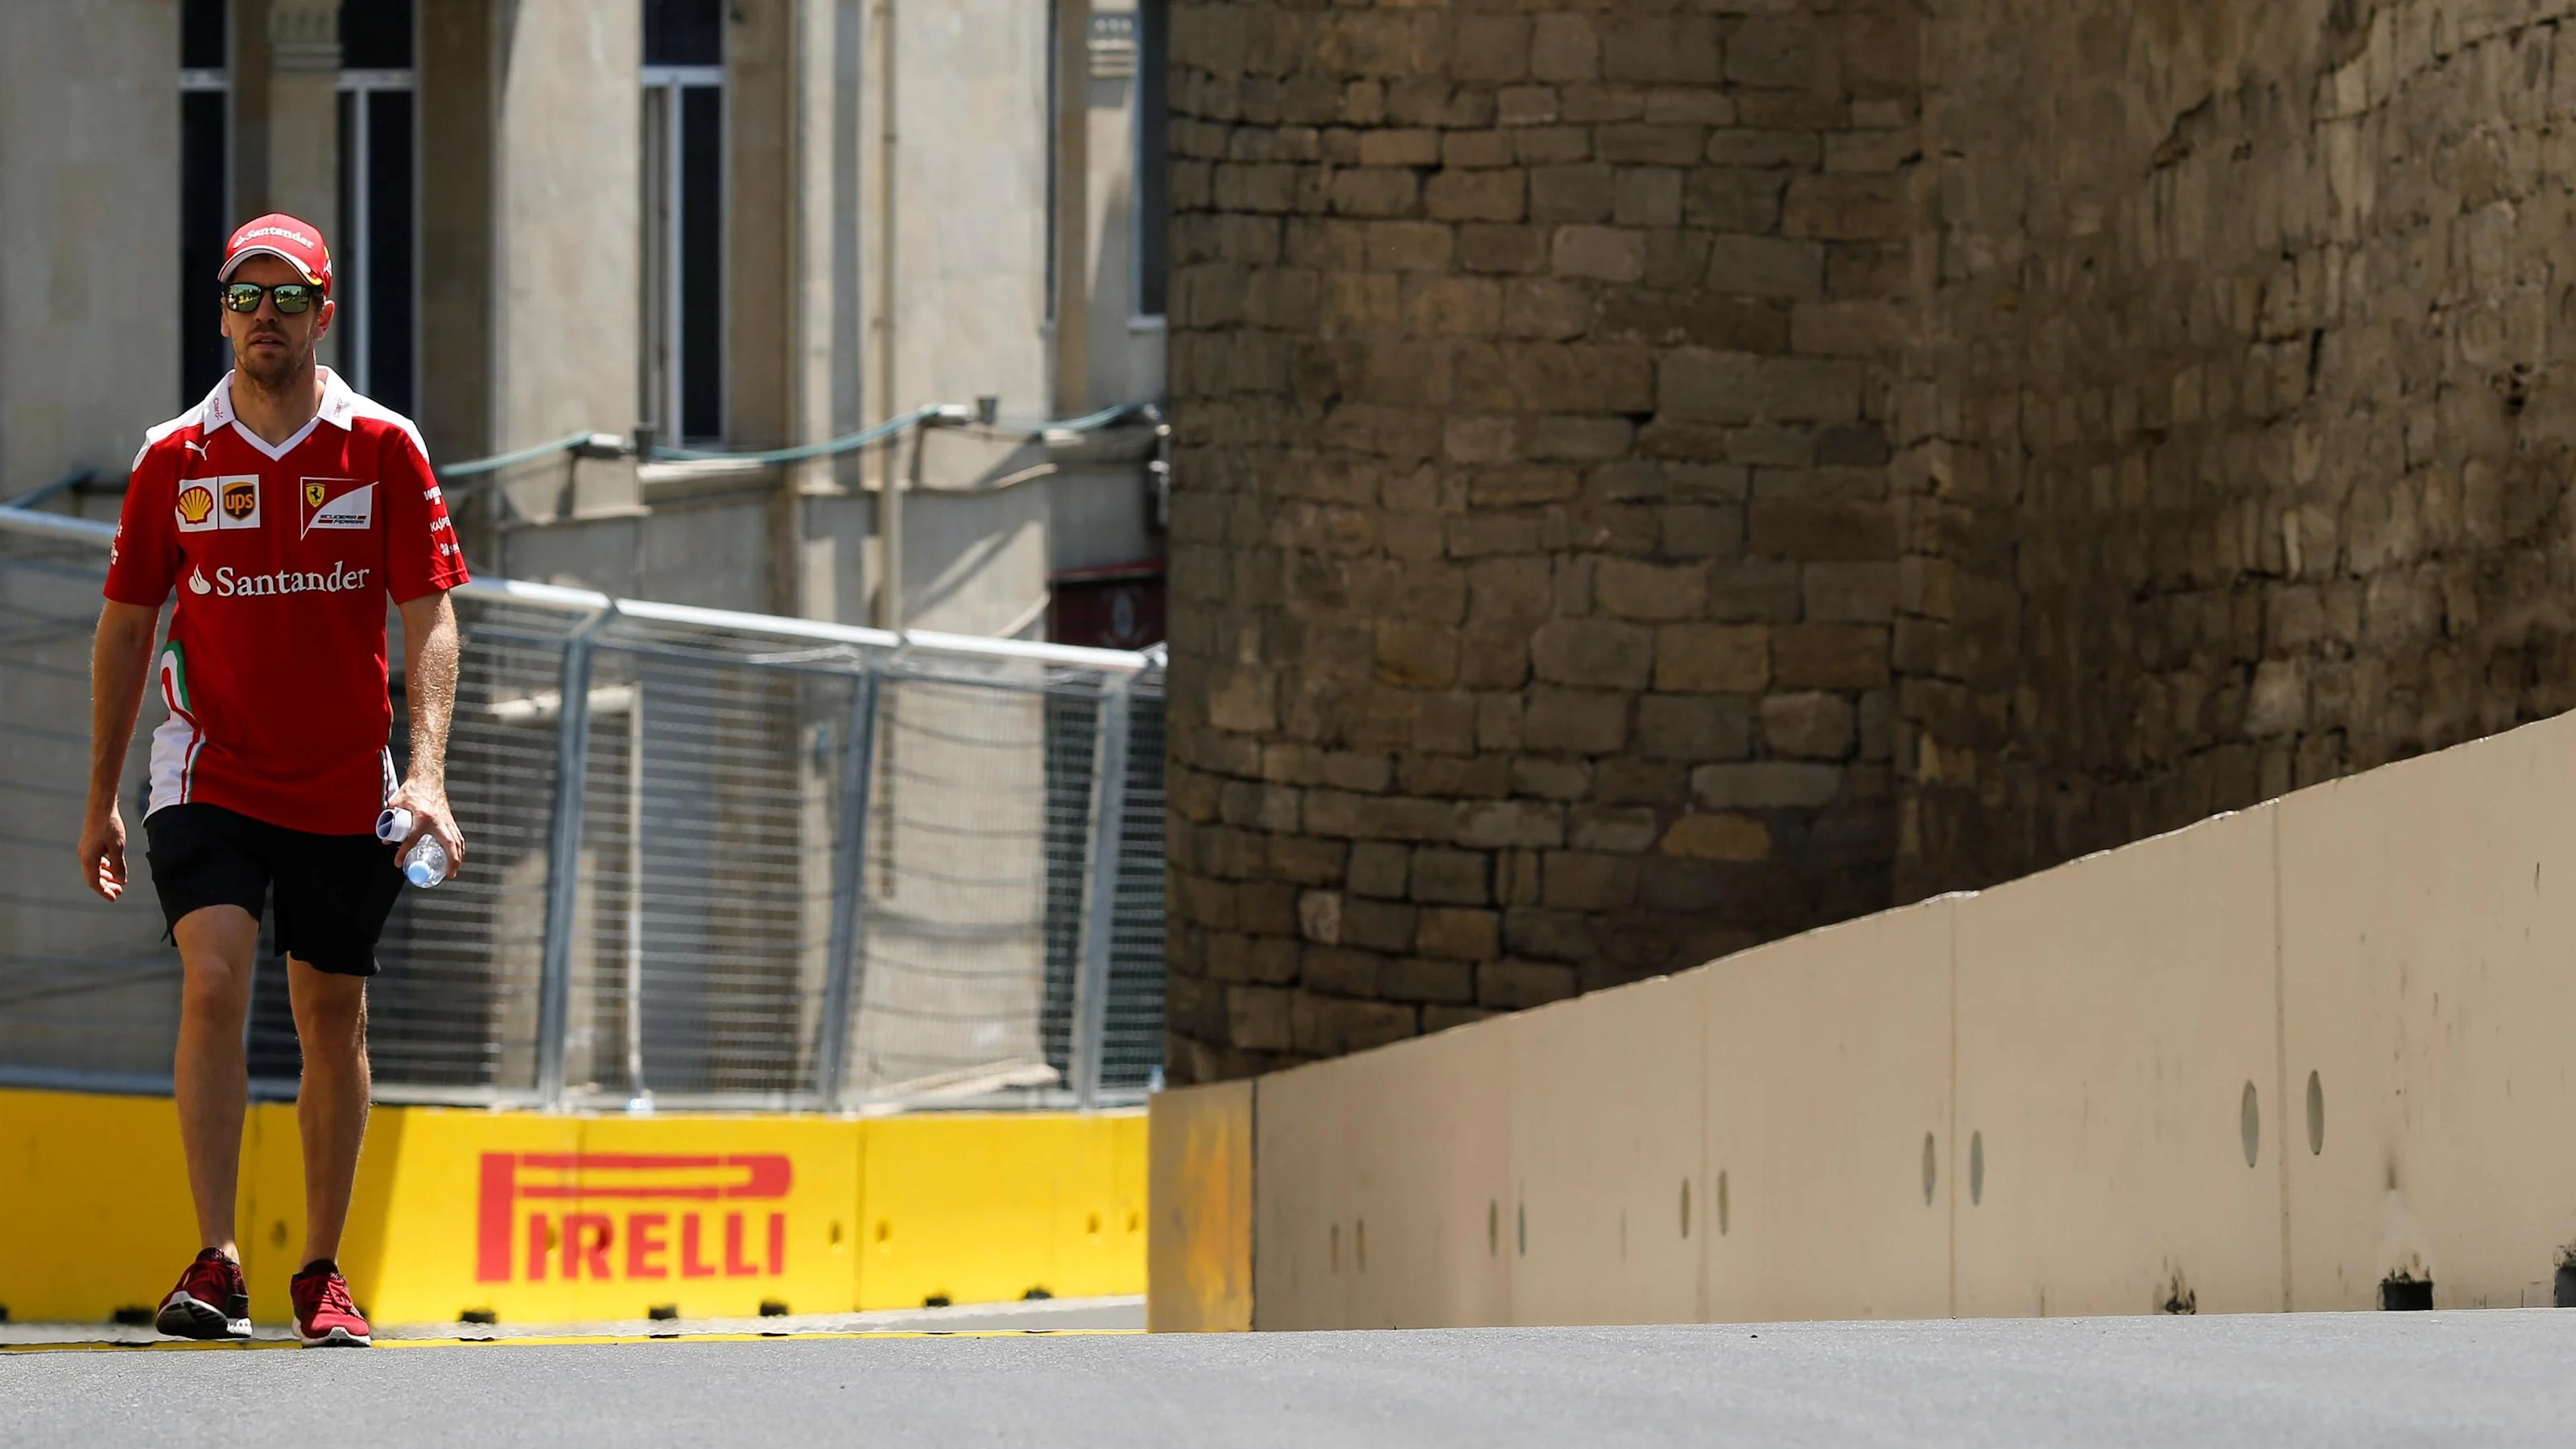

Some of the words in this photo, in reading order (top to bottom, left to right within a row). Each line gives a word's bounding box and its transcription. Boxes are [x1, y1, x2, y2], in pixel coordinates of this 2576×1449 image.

[225, 493, 254, 514] ups
[216, 560, 369, 597] Santander
[476, 1153, 793, 1282] PIRELLI
